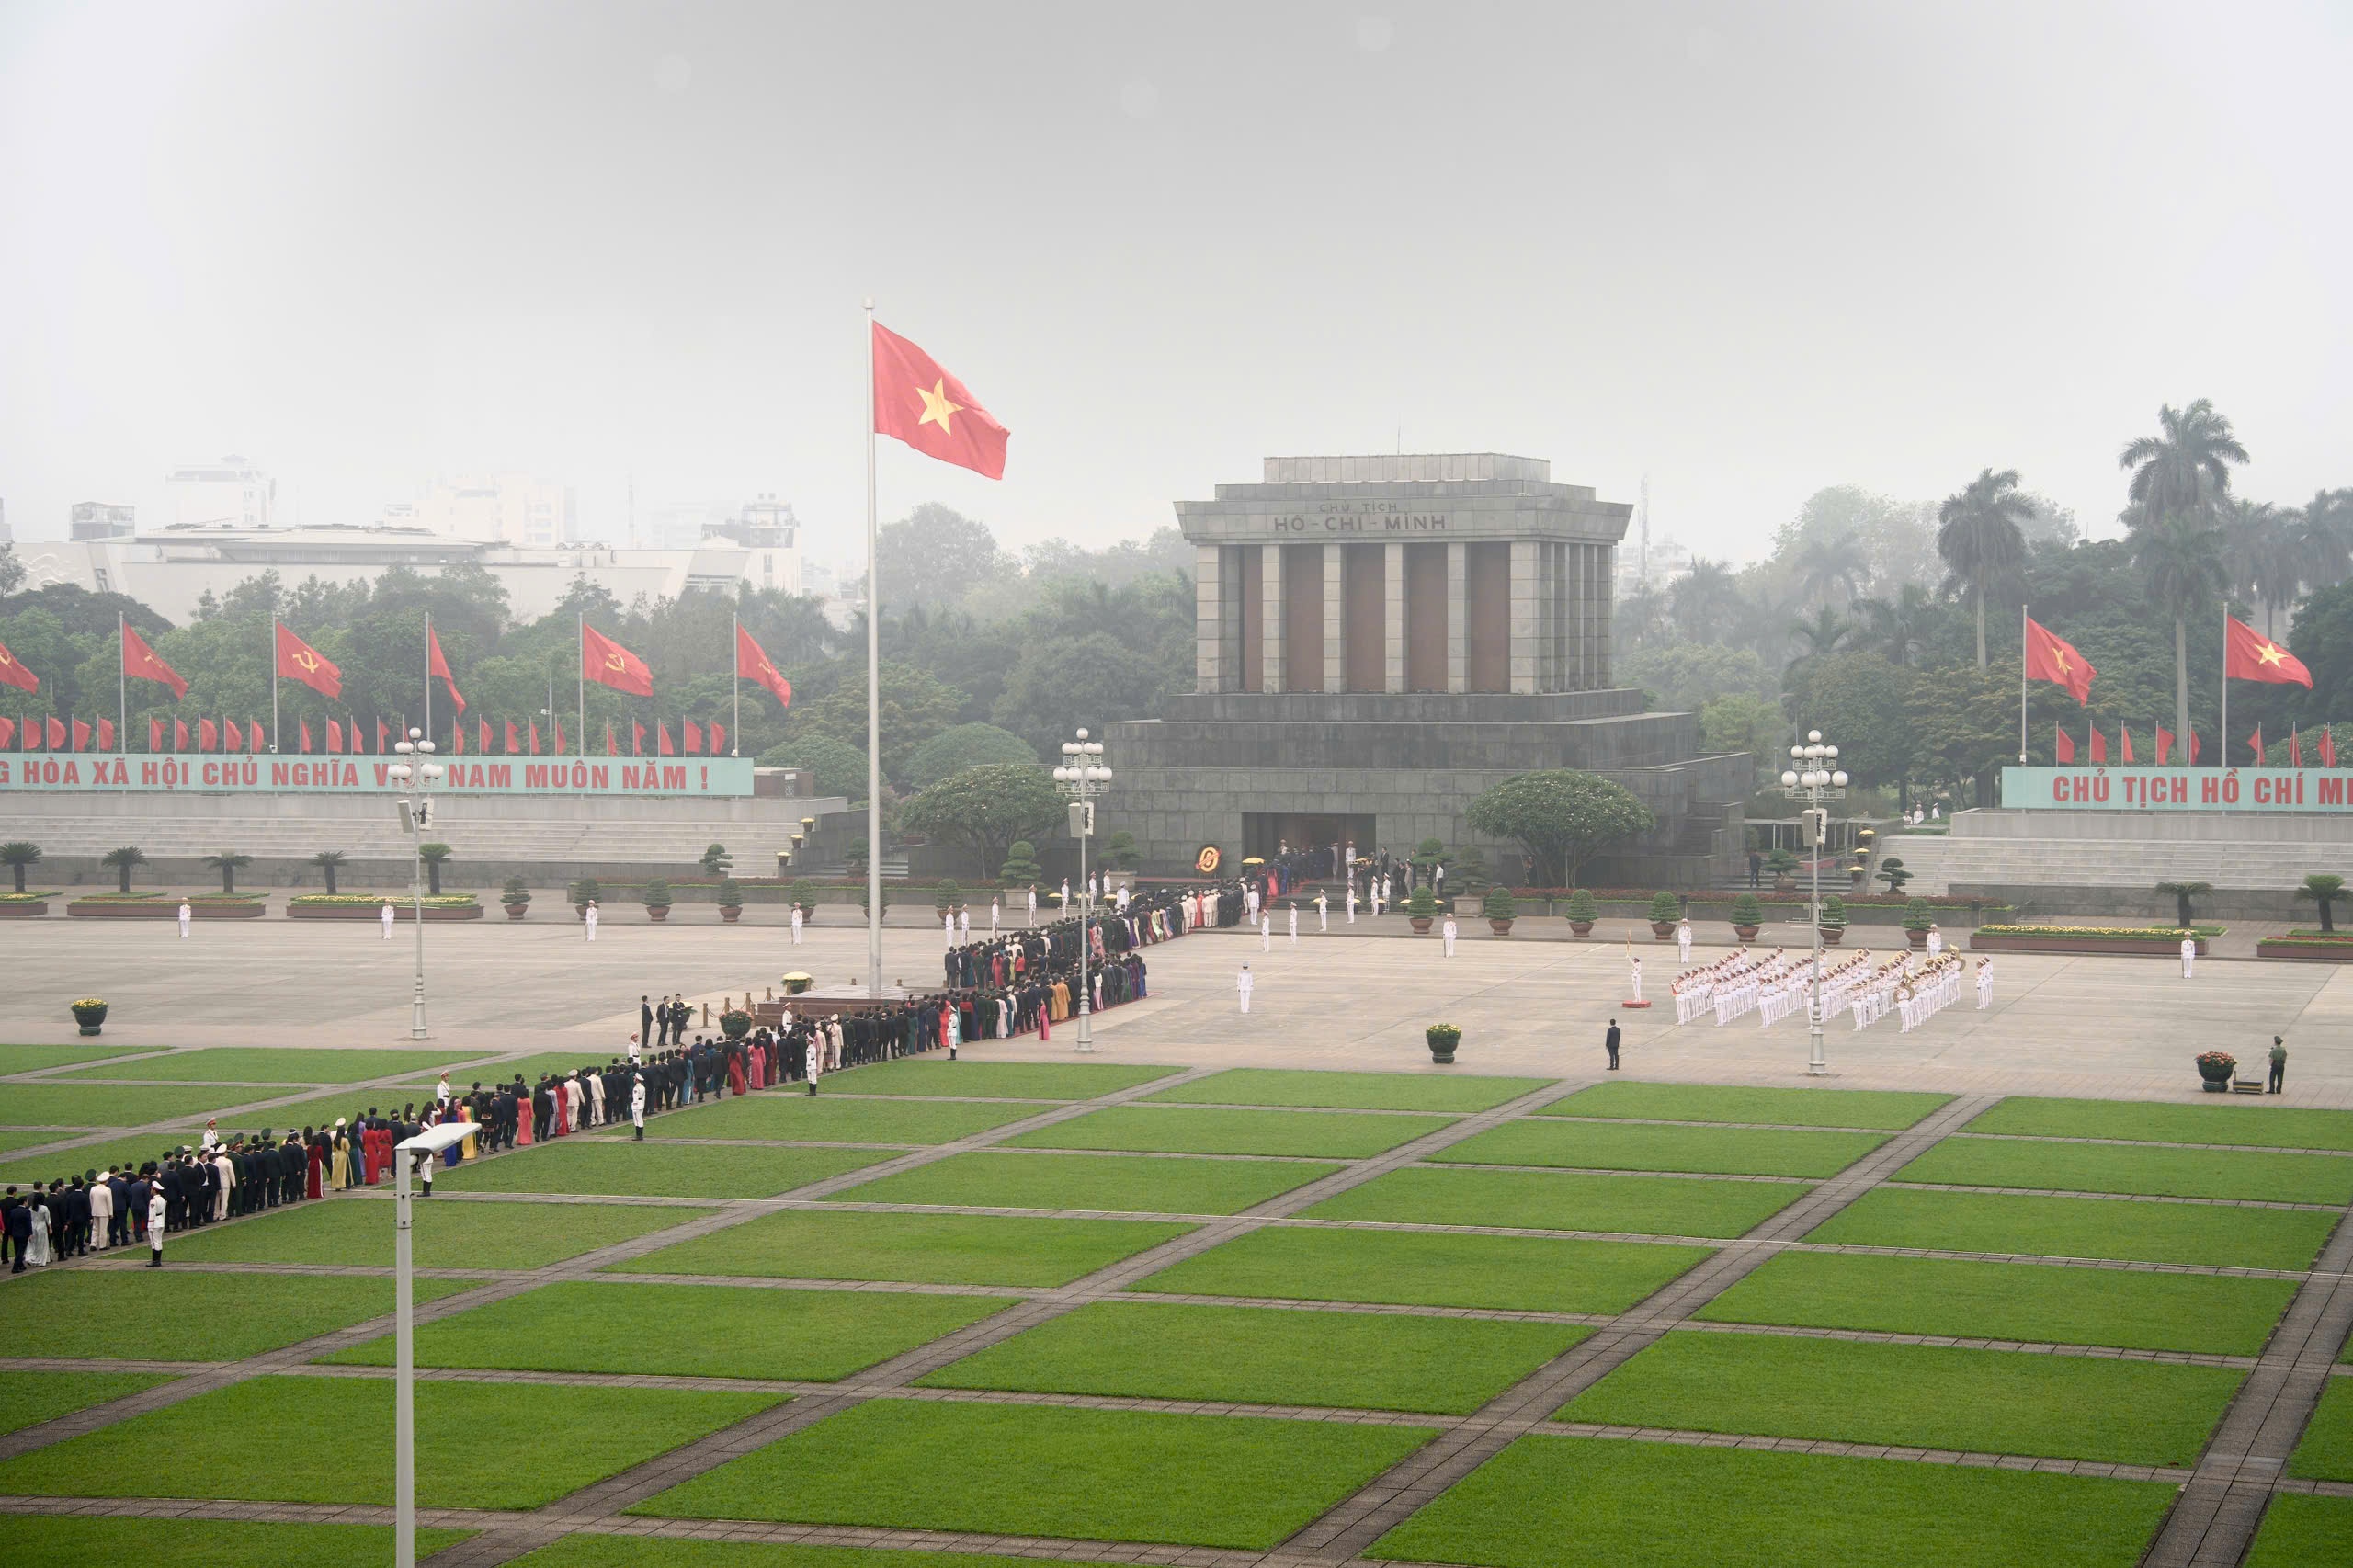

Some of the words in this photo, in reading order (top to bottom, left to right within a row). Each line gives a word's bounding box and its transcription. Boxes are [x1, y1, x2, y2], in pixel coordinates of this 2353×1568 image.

[24, 757, 80, 784] HÒA
[93, 757, 130, 784] XÃ
[142, 757, 189, 789] HỘI
[203, 756, 258, 786] CHỦ
[271, 759, 359, 787] NGHĨA
[448, 764, 512, 788] NAM
[525, 760, 609, 789] MUÔN
[622, 760, 687, 789] NĂM
[2052, 768, 2110, 803] CHỦ
[2122, 777, 2188, 808] TỊCH
[2201, 768, 2240, 804] HỒ
[2253, 772, 2304, 805] CHÍ
